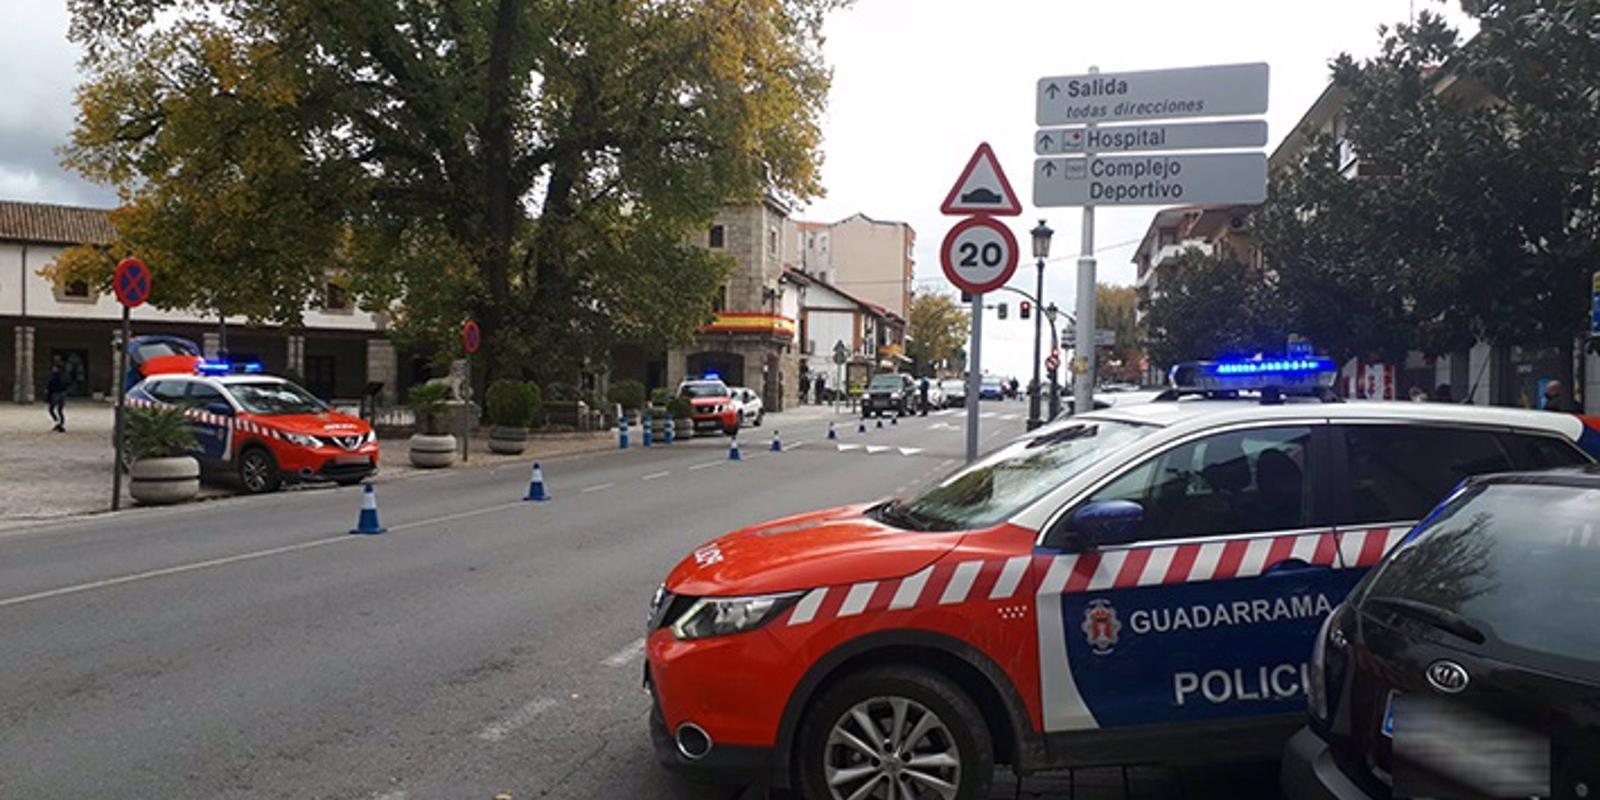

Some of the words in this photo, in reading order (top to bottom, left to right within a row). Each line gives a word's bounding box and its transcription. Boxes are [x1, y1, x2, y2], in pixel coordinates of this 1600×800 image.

[1067, 79, 1128, 98] Salida
[1066, 104, 1107, 119] todas
[1114, 100, 1204, 116] direcciones
[1087, 128, 1165, 150] Hospital
[1090, 158, 1181, 179] Complejo
[1089, 181, 1183, 201] Deportivo
[959, 241, 1003, 267] 20
[1130, 593, 1333, 634] GUADARRAMA
[1173, 662, 1310, 706] POLICI
